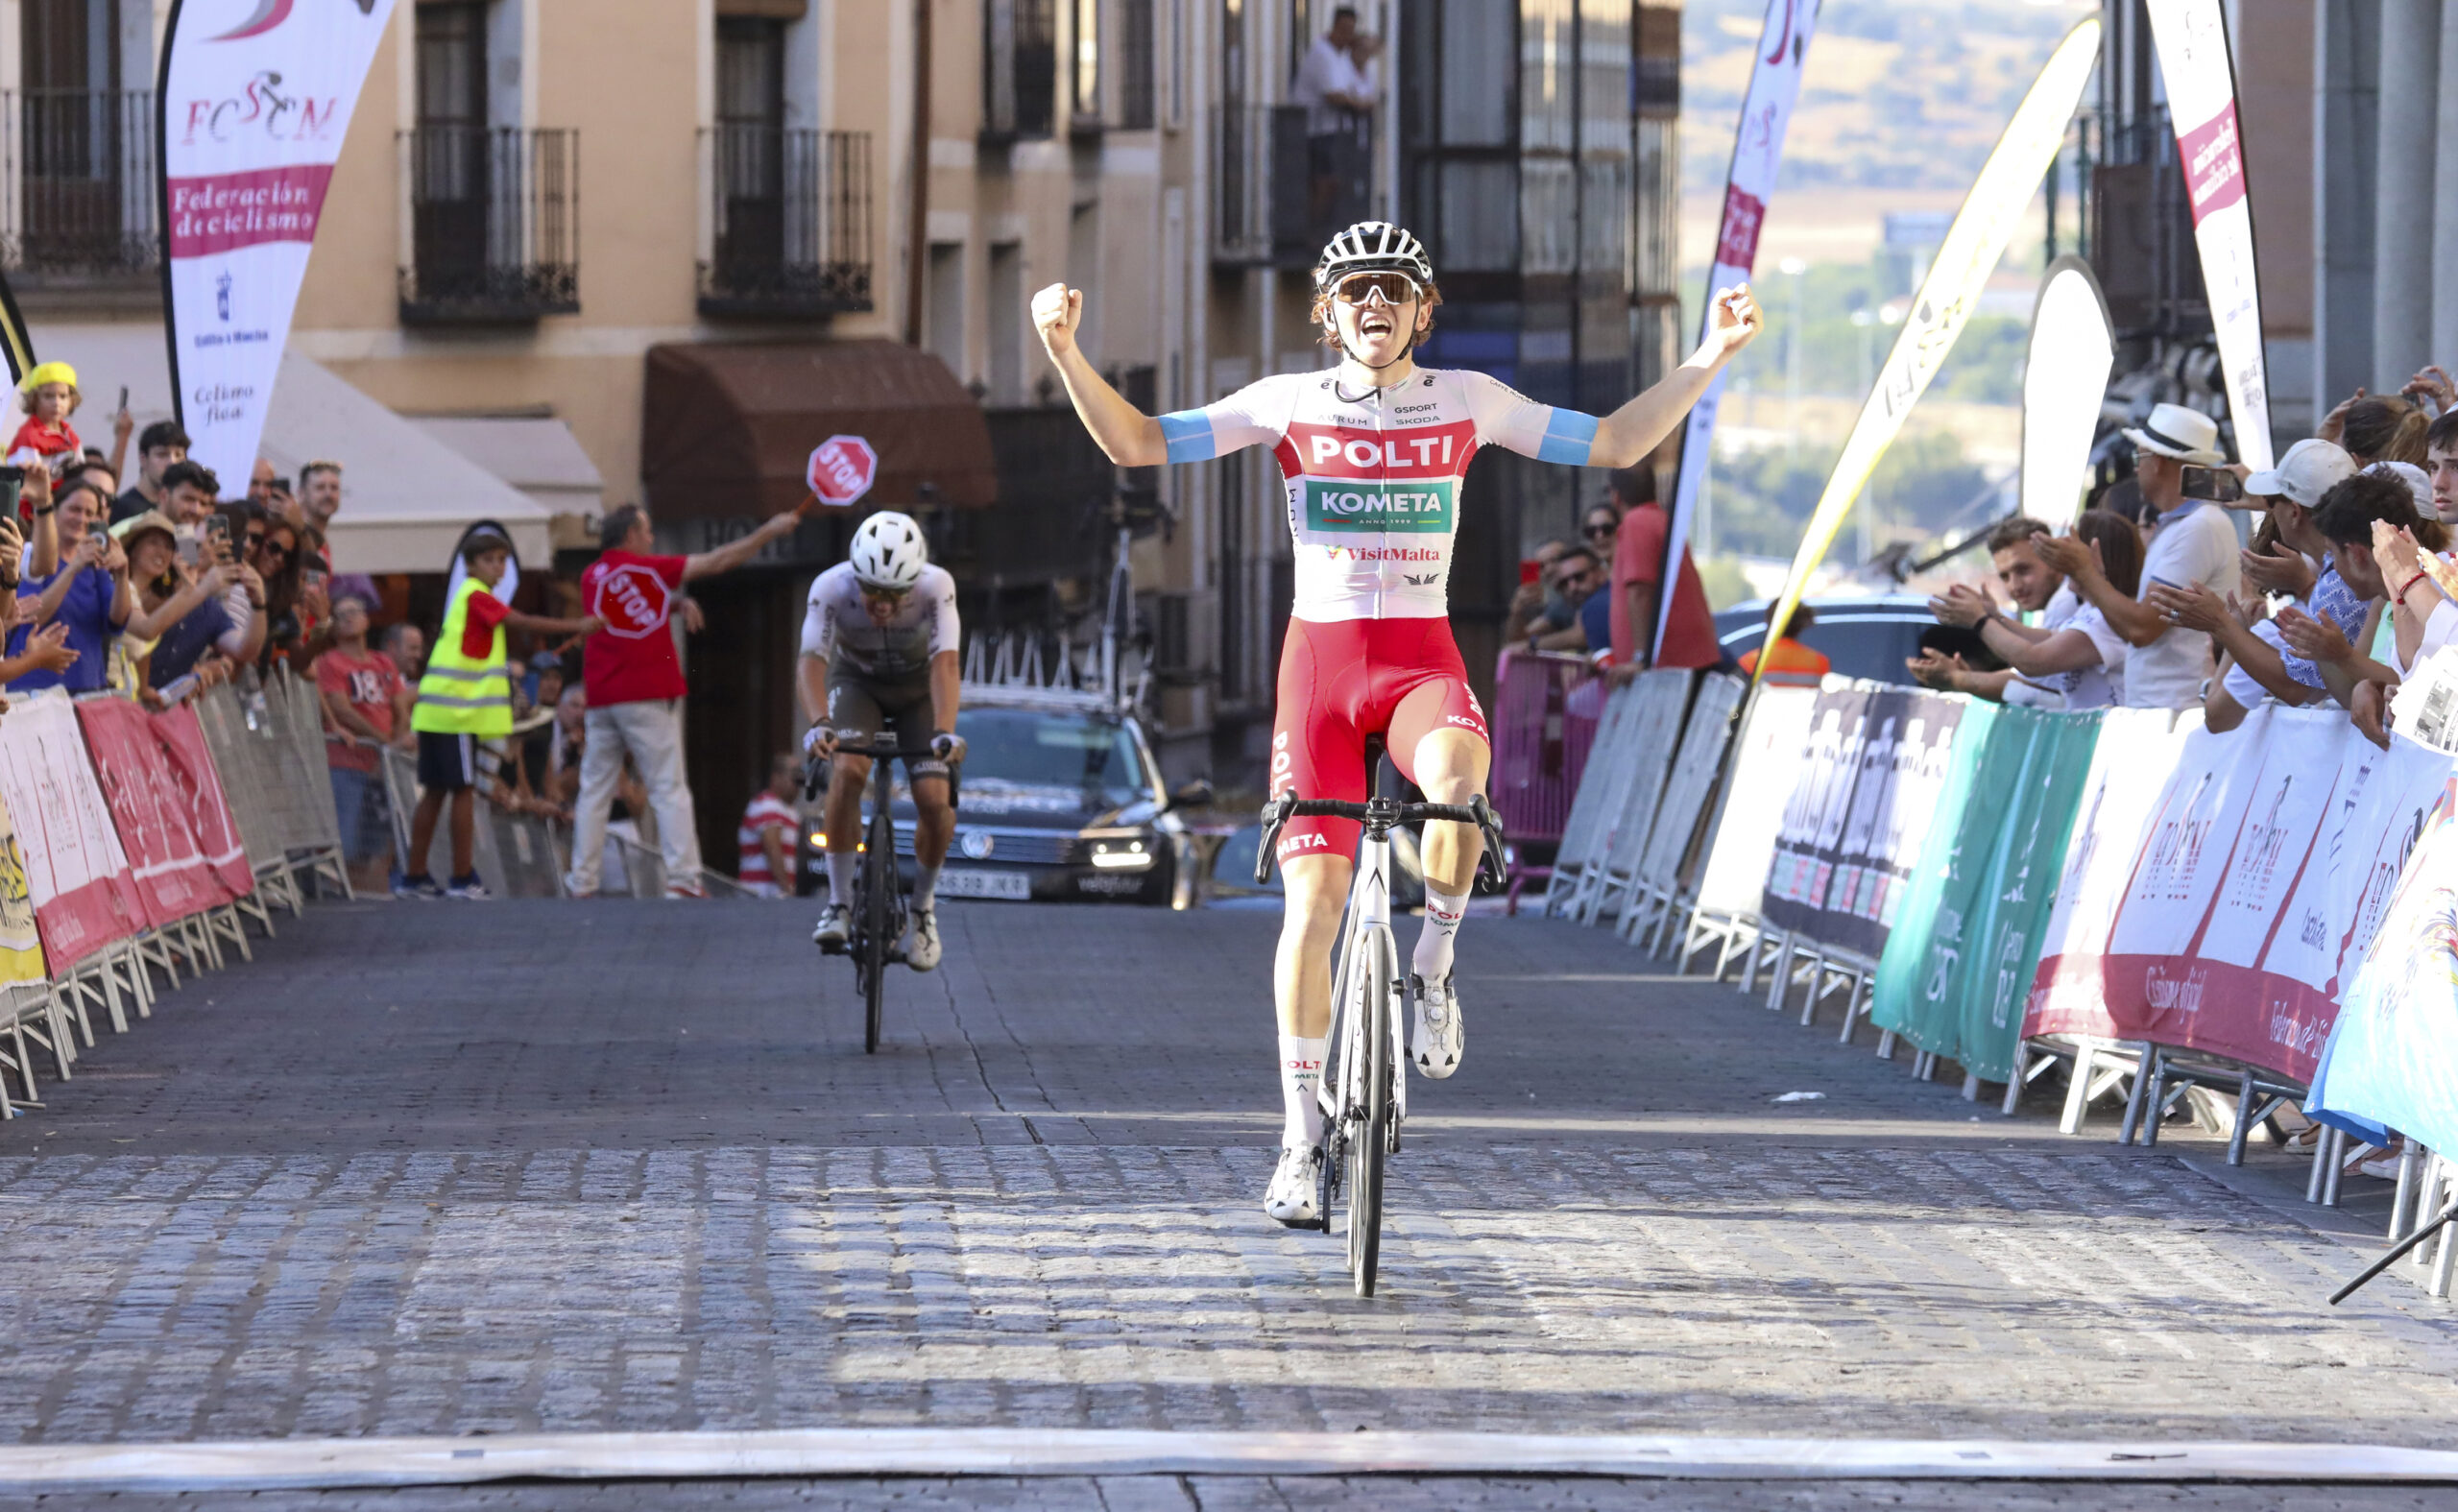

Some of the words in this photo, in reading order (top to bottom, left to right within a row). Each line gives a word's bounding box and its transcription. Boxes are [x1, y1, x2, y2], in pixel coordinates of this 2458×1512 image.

[1394, 403, 1437, 414] GSPORT
[1311, 435, 1453, 468] POLTI
[819, 444, 864, 492] STOP
[1321, 492, 1442, 516] KOMETA
[1347, 547, 1439, 562] VisitMalta
[608, 573, 657, 626] STOP
